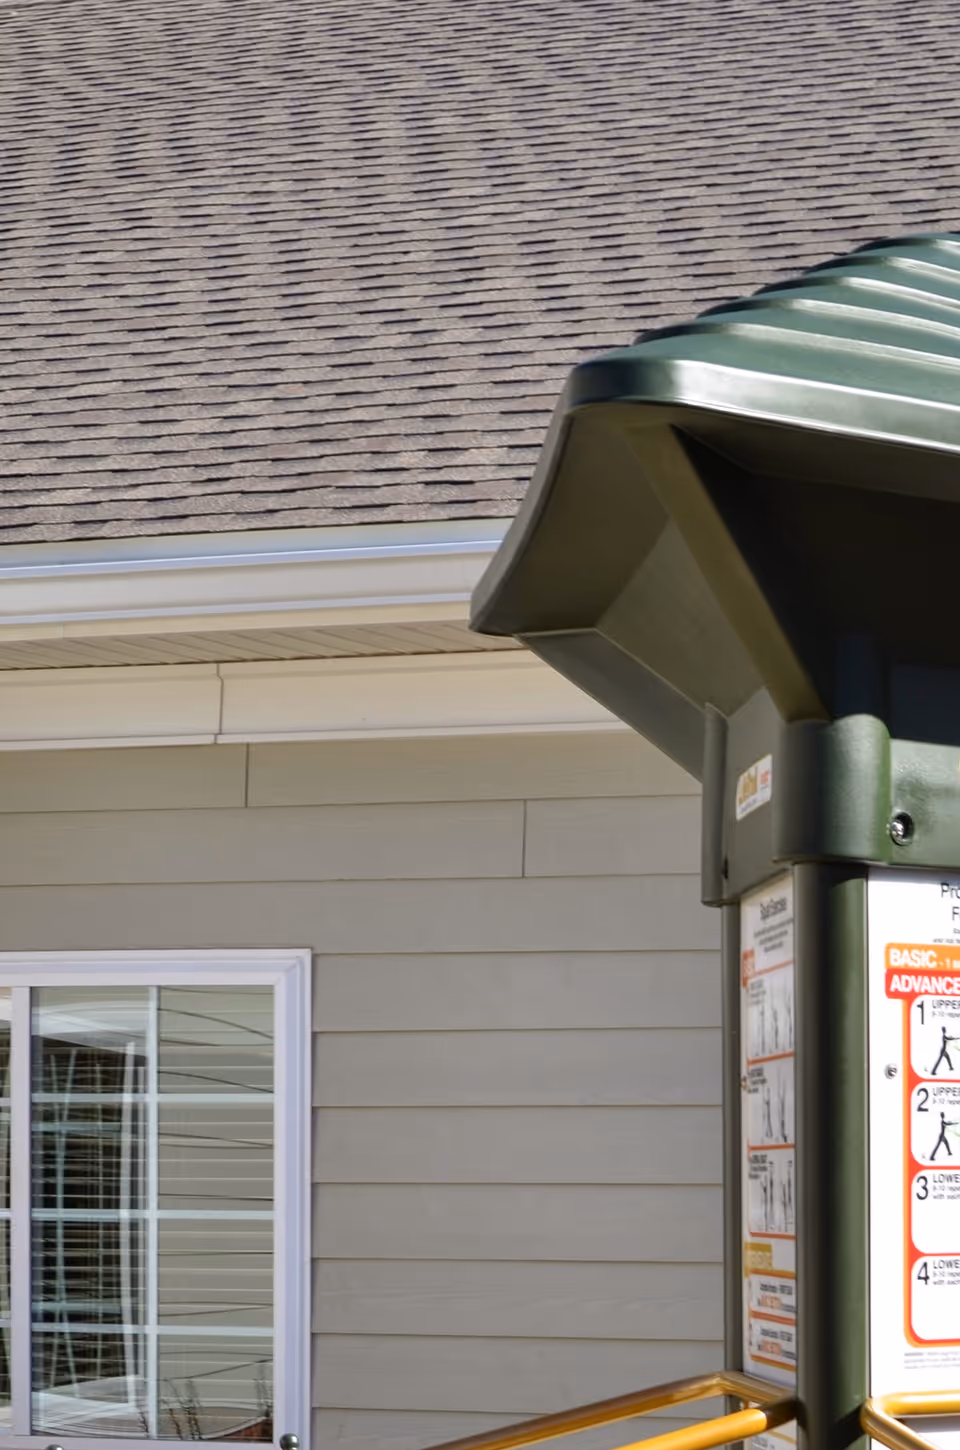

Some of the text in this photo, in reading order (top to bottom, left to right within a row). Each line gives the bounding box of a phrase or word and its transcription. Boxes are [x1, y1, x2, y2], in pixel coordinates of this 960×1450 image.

[889, 949, 937, 967] BASIC
[946, 959, 950, 967] 1
[917, 1001, 924, 1025] 1
[917, 1087, 929, 1112] 2
[916, 1176, 929, 1200] 3
[917, 1261, 930, 1285] 4
